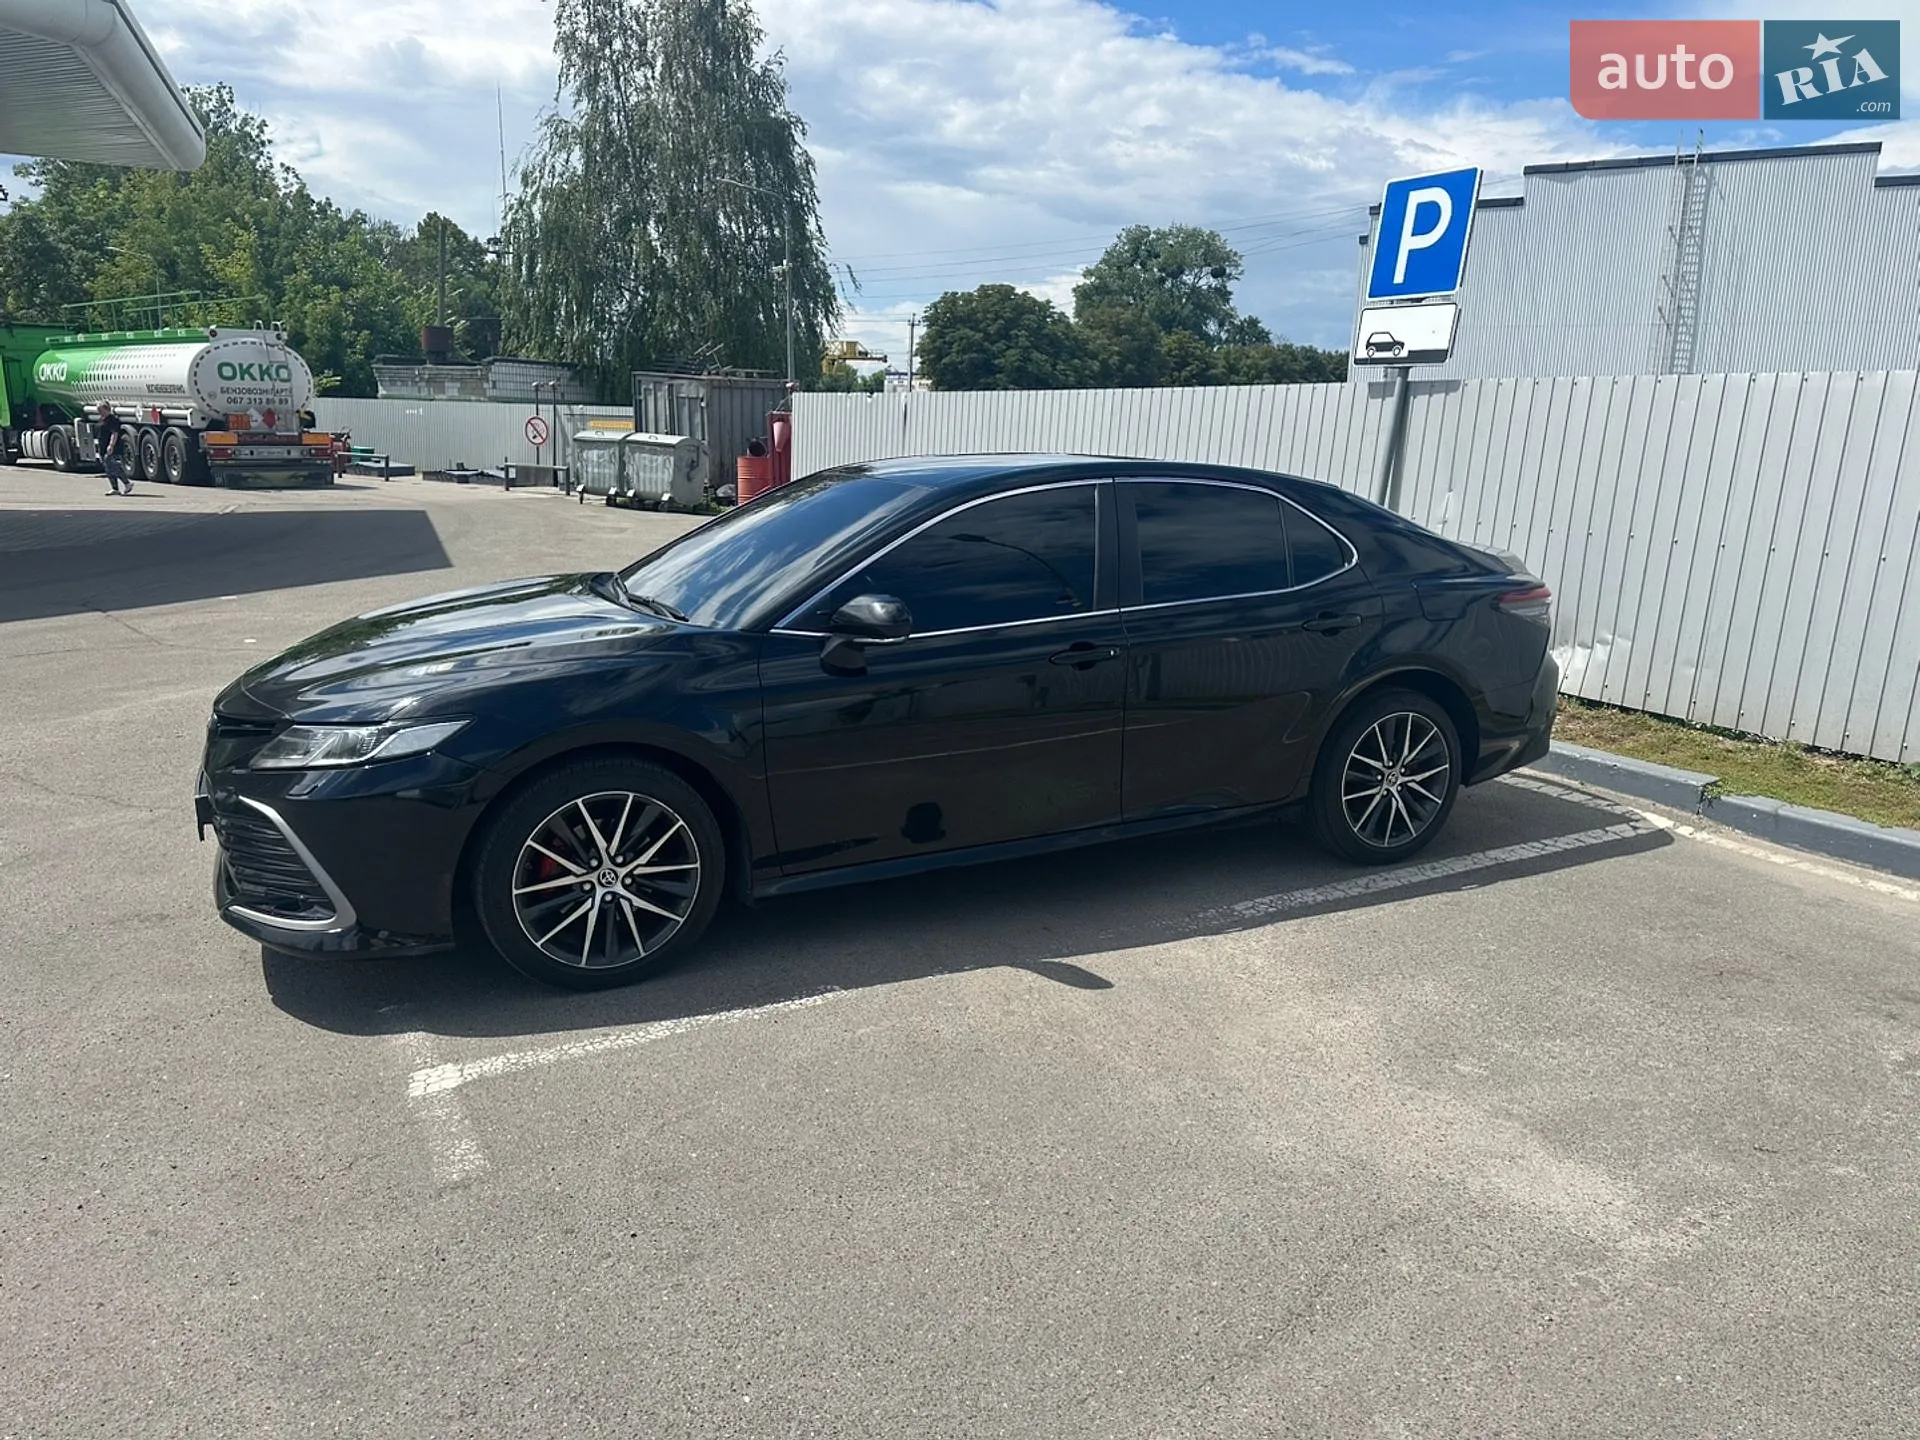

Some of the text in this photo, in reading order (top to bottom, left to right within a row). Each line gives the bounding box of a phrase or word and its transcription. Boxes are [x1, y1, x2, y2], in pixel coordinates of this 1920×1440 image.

[1392, 186, 1452, 285] P
[38, 362, 67, 381] OKKO
[217, 361, 292, 382] OKKO
